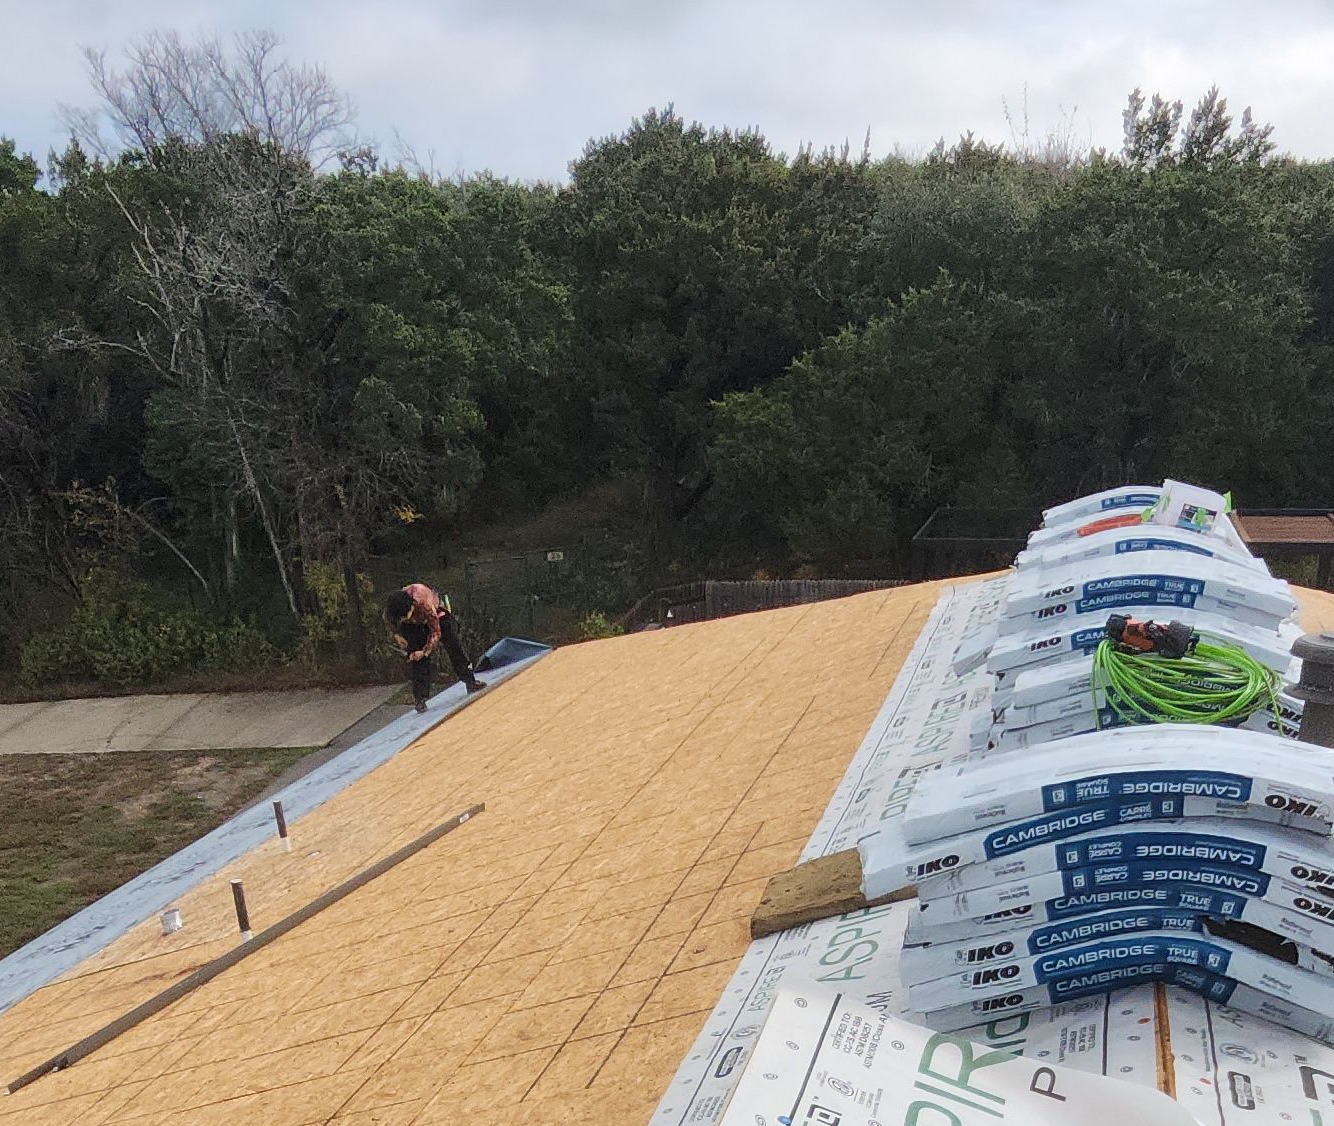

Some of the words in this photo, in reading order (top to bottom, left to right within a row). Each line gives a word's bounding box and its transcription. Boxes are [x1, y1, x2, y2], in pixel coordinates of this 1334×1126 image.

[1045, 585, 1075, 599] IKO
[1087, 579, 1158, 591] CAMBRIDGE
[1080, 592, 1150, 608] CAMBRIDGE
[1037, 604, 1068, 619] IKO
[1030, 636, 1062, 652] IKO
[1076, 786, 1109, 798] TRUE
[1122, 782, 1241, 798] CAMBRIDGE
[1265, 794, 1317, 816] IKO
[992, 810, 1107, 849] CAMBRIDGE
[917, 854, 959, 876] IKO
[1136, 845, 1254, 865] CAMBRIDGE
[1142, 870, 1259, 893] CAMBRIDGE
[1055, 890, 1167, 909] CAMBRIDGE
[1179, 894, 1212, 905] TRUE
[1037, 917, 1149, 947] CAMBRIDGE
[1162, 917, 1195, 927] TRUE
[967, 941, 1014, 962] IKO
[1042, 945, 1155, 972] CAMBRIDGE
[1167, 947, 1198, 958] TRUE
[973, 965, 1020, 985] IKO
[1056, 964, 1165, 991] CAMBRIDGE
[982, 995, 1023, 1011] IKO
